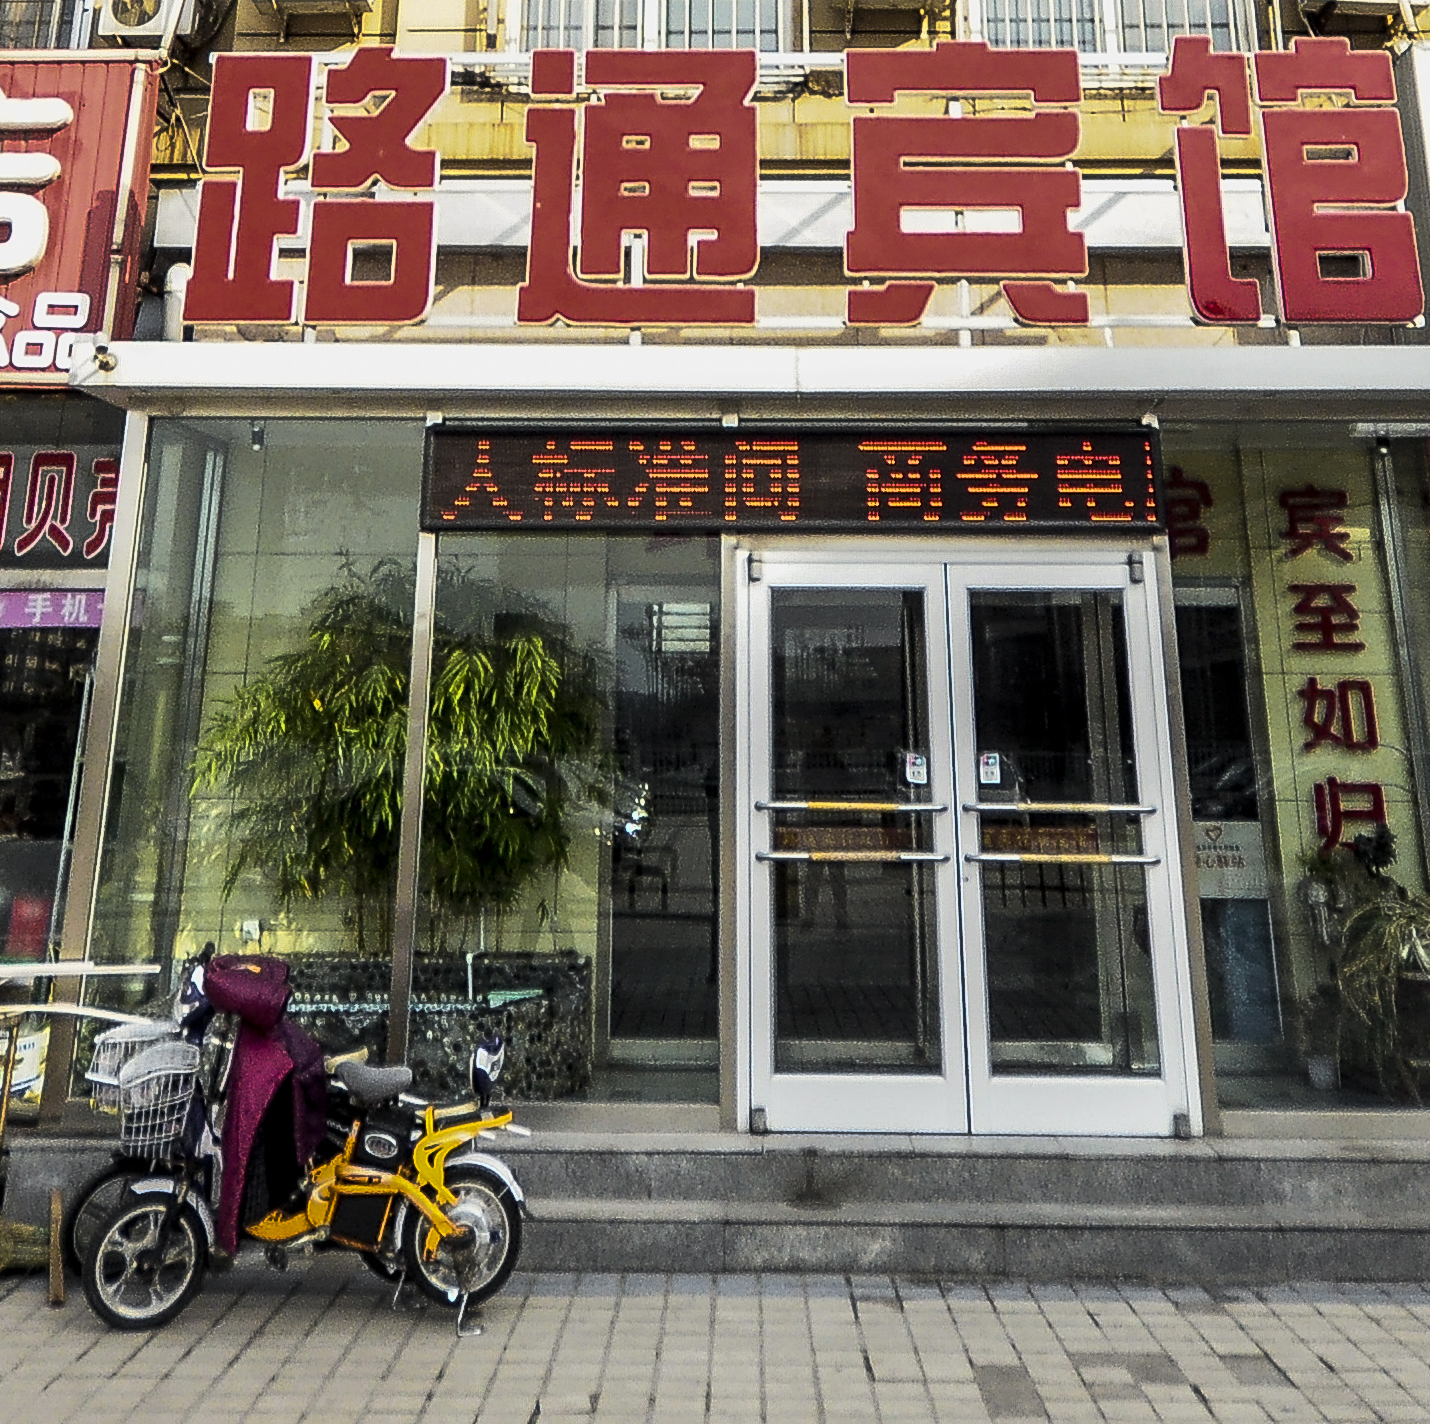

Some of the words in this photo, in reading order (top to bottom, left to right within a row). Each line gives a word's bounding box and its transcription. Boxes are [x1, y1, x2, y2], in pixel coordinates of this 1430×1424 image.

[181, 35, 1425, 327] 路通宾馆
[25, 593, 104, 624] 手机
[1278, 484, 1388, 854] 宾至如归
